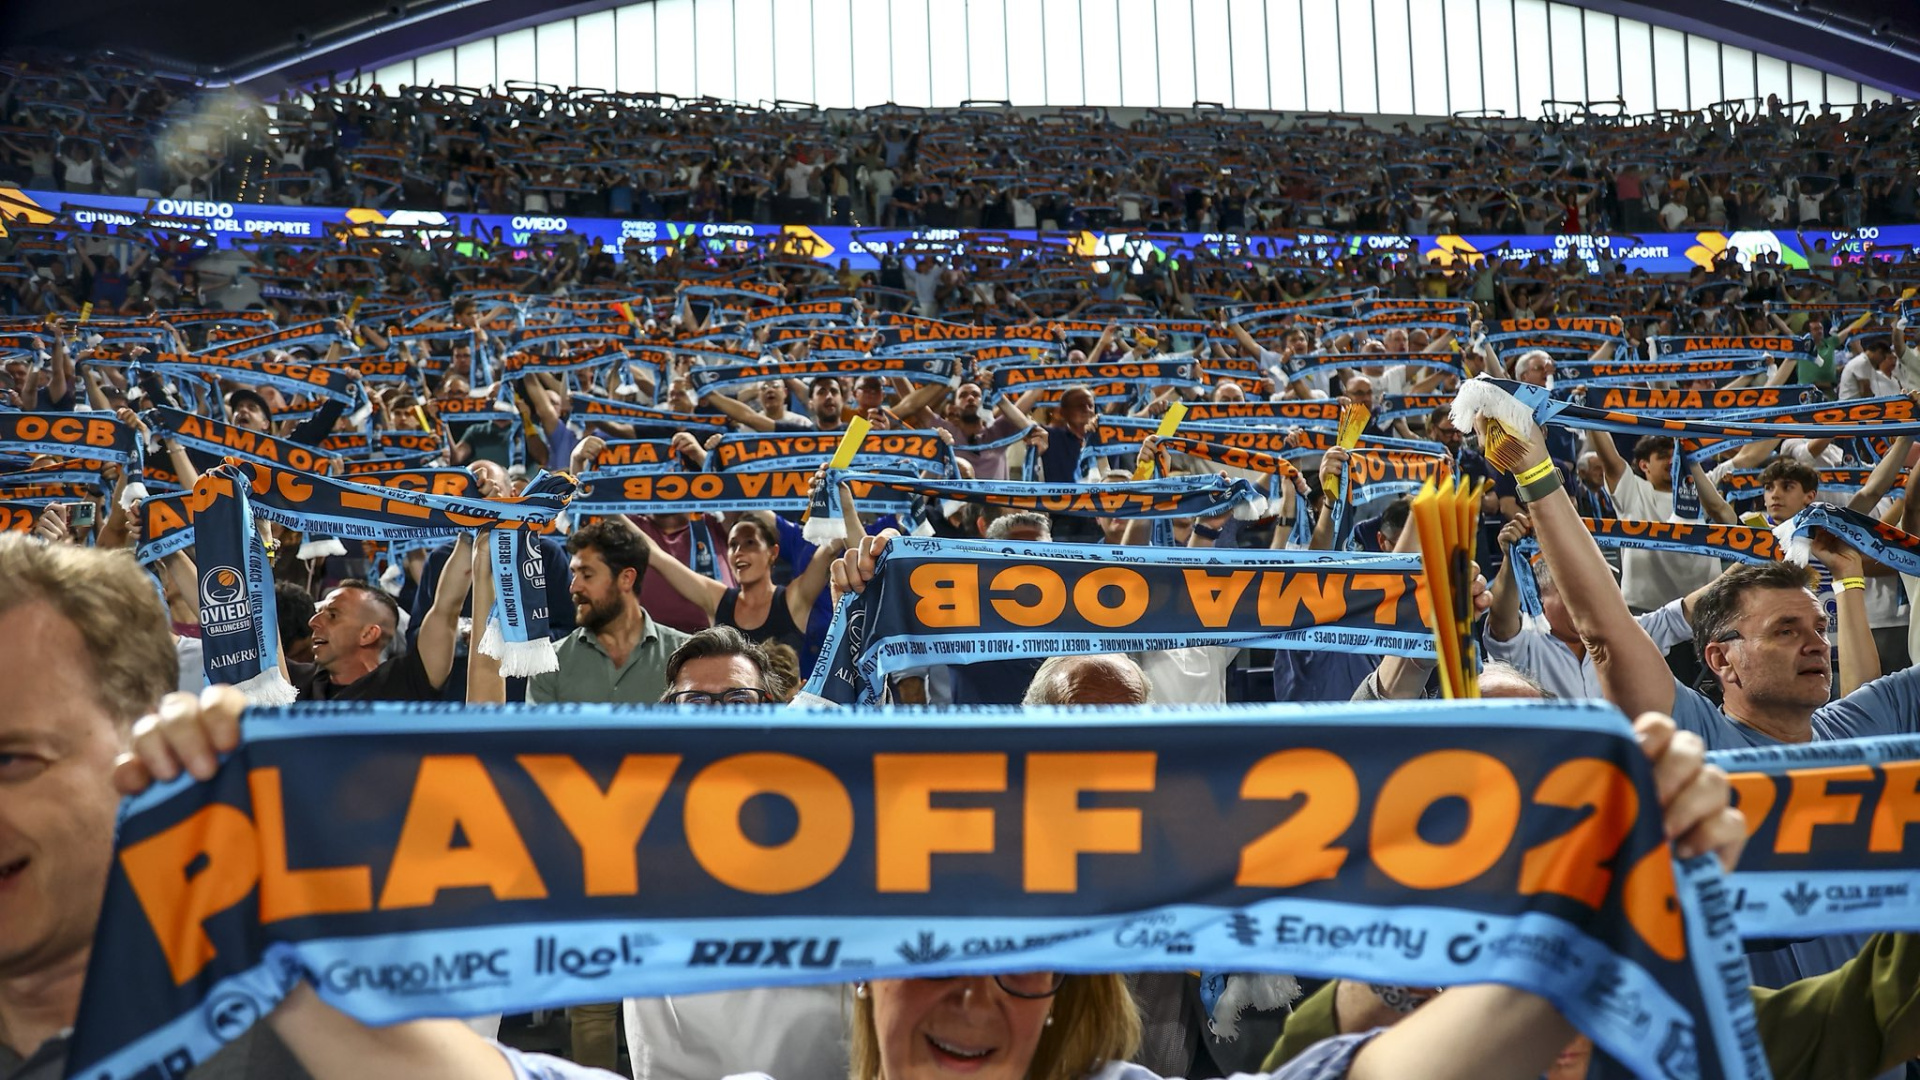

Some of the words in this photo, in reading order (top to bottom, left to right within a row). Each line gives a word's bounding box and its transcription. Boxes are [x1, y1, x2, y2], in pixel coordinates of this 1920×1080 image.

[158, 199, 234, 219] OVIEDO
[213, 218, 243, 232] DEL
[244, 220, 311, 235] DEPORTE
[512, 217, 567, 231] OVIEDO
[749, 306, 794, 321] LMA
[799, 302, 843, 314] OCB
[587, 324, 631, 335] OCB
[900, 325, 998, 343] PLAYOFF
[1003, 325, 1055, 342] 2026
[1501, 318, 1551, 332] OCB
[1556, 318, 1622, 337] ALMA
[821, 335, 872, 353] ALM
[1684, 337, 1745, 351] ALMA
[1750, 337, 1794, 351] OCB
[157, 351, 253, 370] ALMA
[261, 362, 331, 386] OCB
[838, 358, 906, 372] OCB
[1007, 365, 1093, 386] ALMA
[1099, 363, 1161, 378] OCB
[437, 399, 486, 413] YOFF
[1603, 387, 1703, 409] ALMA
[1712, 389, 1781, 409] OCB
[1190, 404, 1275, 421] ALMA
[1281, 403, 1340, 420] OCB
[1811, 400, 1915, 424] OCB
[15, 416, 116, 447] OCB
[178, 414, 280, 463] ALMA
[288, 448, 329, 476] OC
[864, 435, 938, 459] 2026
[1223, 432, 1285, 451] 2026
[598, 443, 660, 466] MA
[622, 474, 724, 500] OCB
[1731, 471, 1851, 489] PLFF
[271, 511, 300, 529] ROBERT
[345, 522, 377, 538] FRANCIS
[382, 527, 431, 540] HERMANSON
[498, 531, 511, 565] GREGORY
[249, 556, 263, 583] LOBACO
[500, 572, 513, 600] FAURE
[250, 590, 264, 615] JAVIER
[908, 562, 1150, 629] OCB
[504, 600, 519, 627] ALONSO
[210, 619, 250, 635] BALONCESTO
[932, 640, 976, 654] LONGARELA
[978, 638, 986, 653] G.
[986, 638, 1014, 653] PABLO
[1022, 638, 1060, 653] COSIALLS
[1061, 638, 1091, 653] ROBERT
[1099, 638, 1144, 652] NWAOKORIE
[1144, 638, 1178, 651] FRANCIS
[1313, 631, 1337, 646] COPES
[1338, 632, 1370, 647] FEDERICO
[1404, 638, 1419, 650] DAN
[884, 640, 908, 657] ARIAS
[120, 750, 1158, 987] PLAYOFF
[1274, 913, 1428, 960] Enerthy
